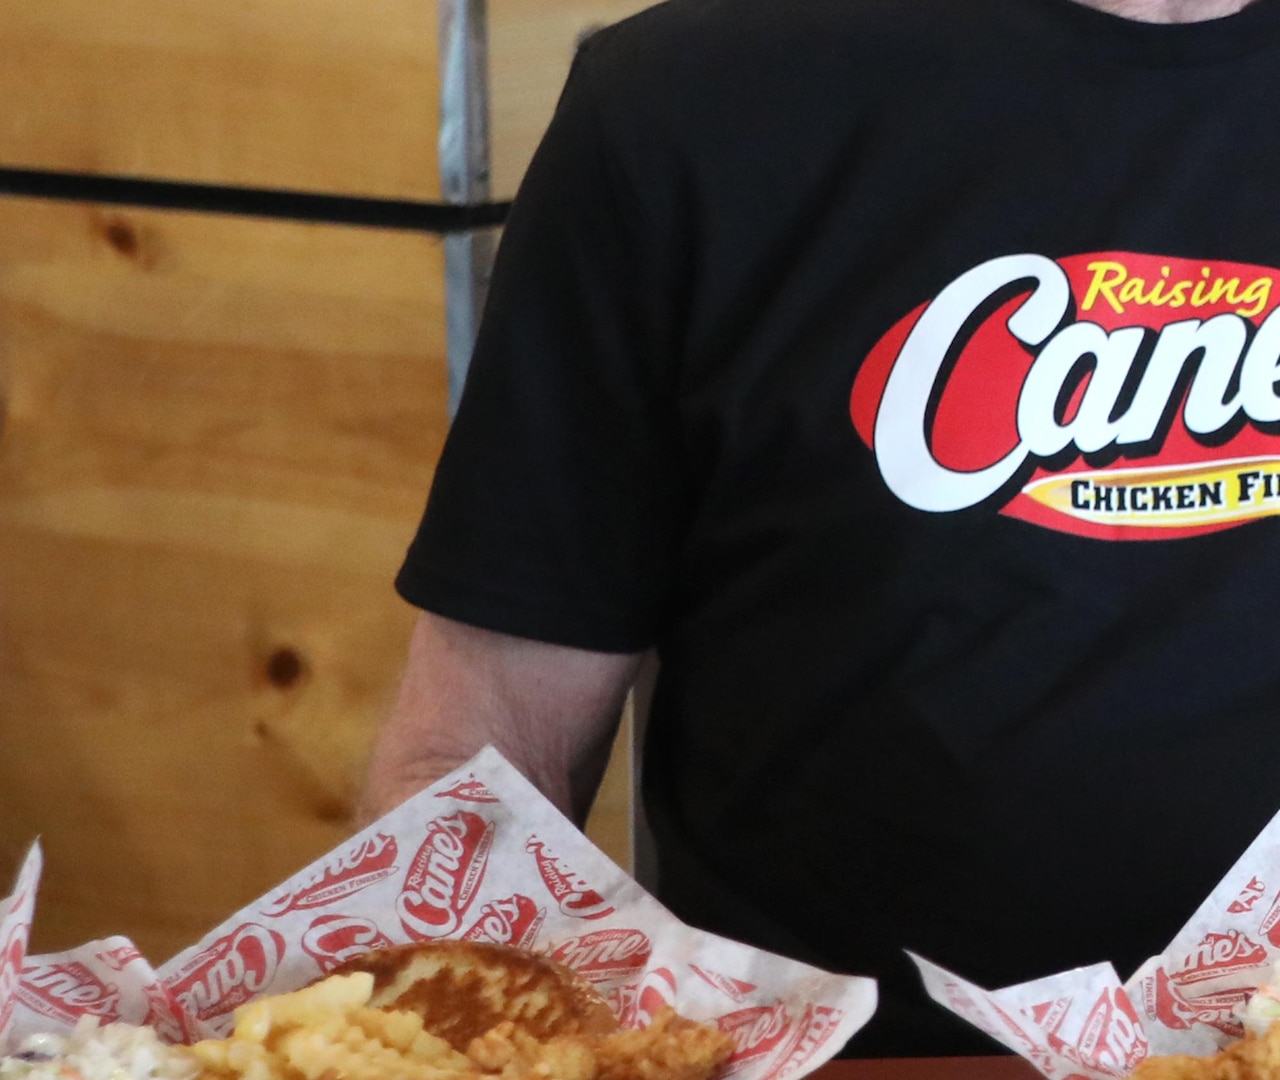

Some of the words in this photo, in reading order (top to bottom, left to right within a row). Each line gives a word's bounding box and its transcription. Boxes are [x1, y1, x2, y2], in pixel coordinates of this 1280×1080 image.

[1080, 261, 1273, 318] Raising
[1070, 480, 1223, 513] CHICKEN
[459, 863, 478, 901] CHICKEN
